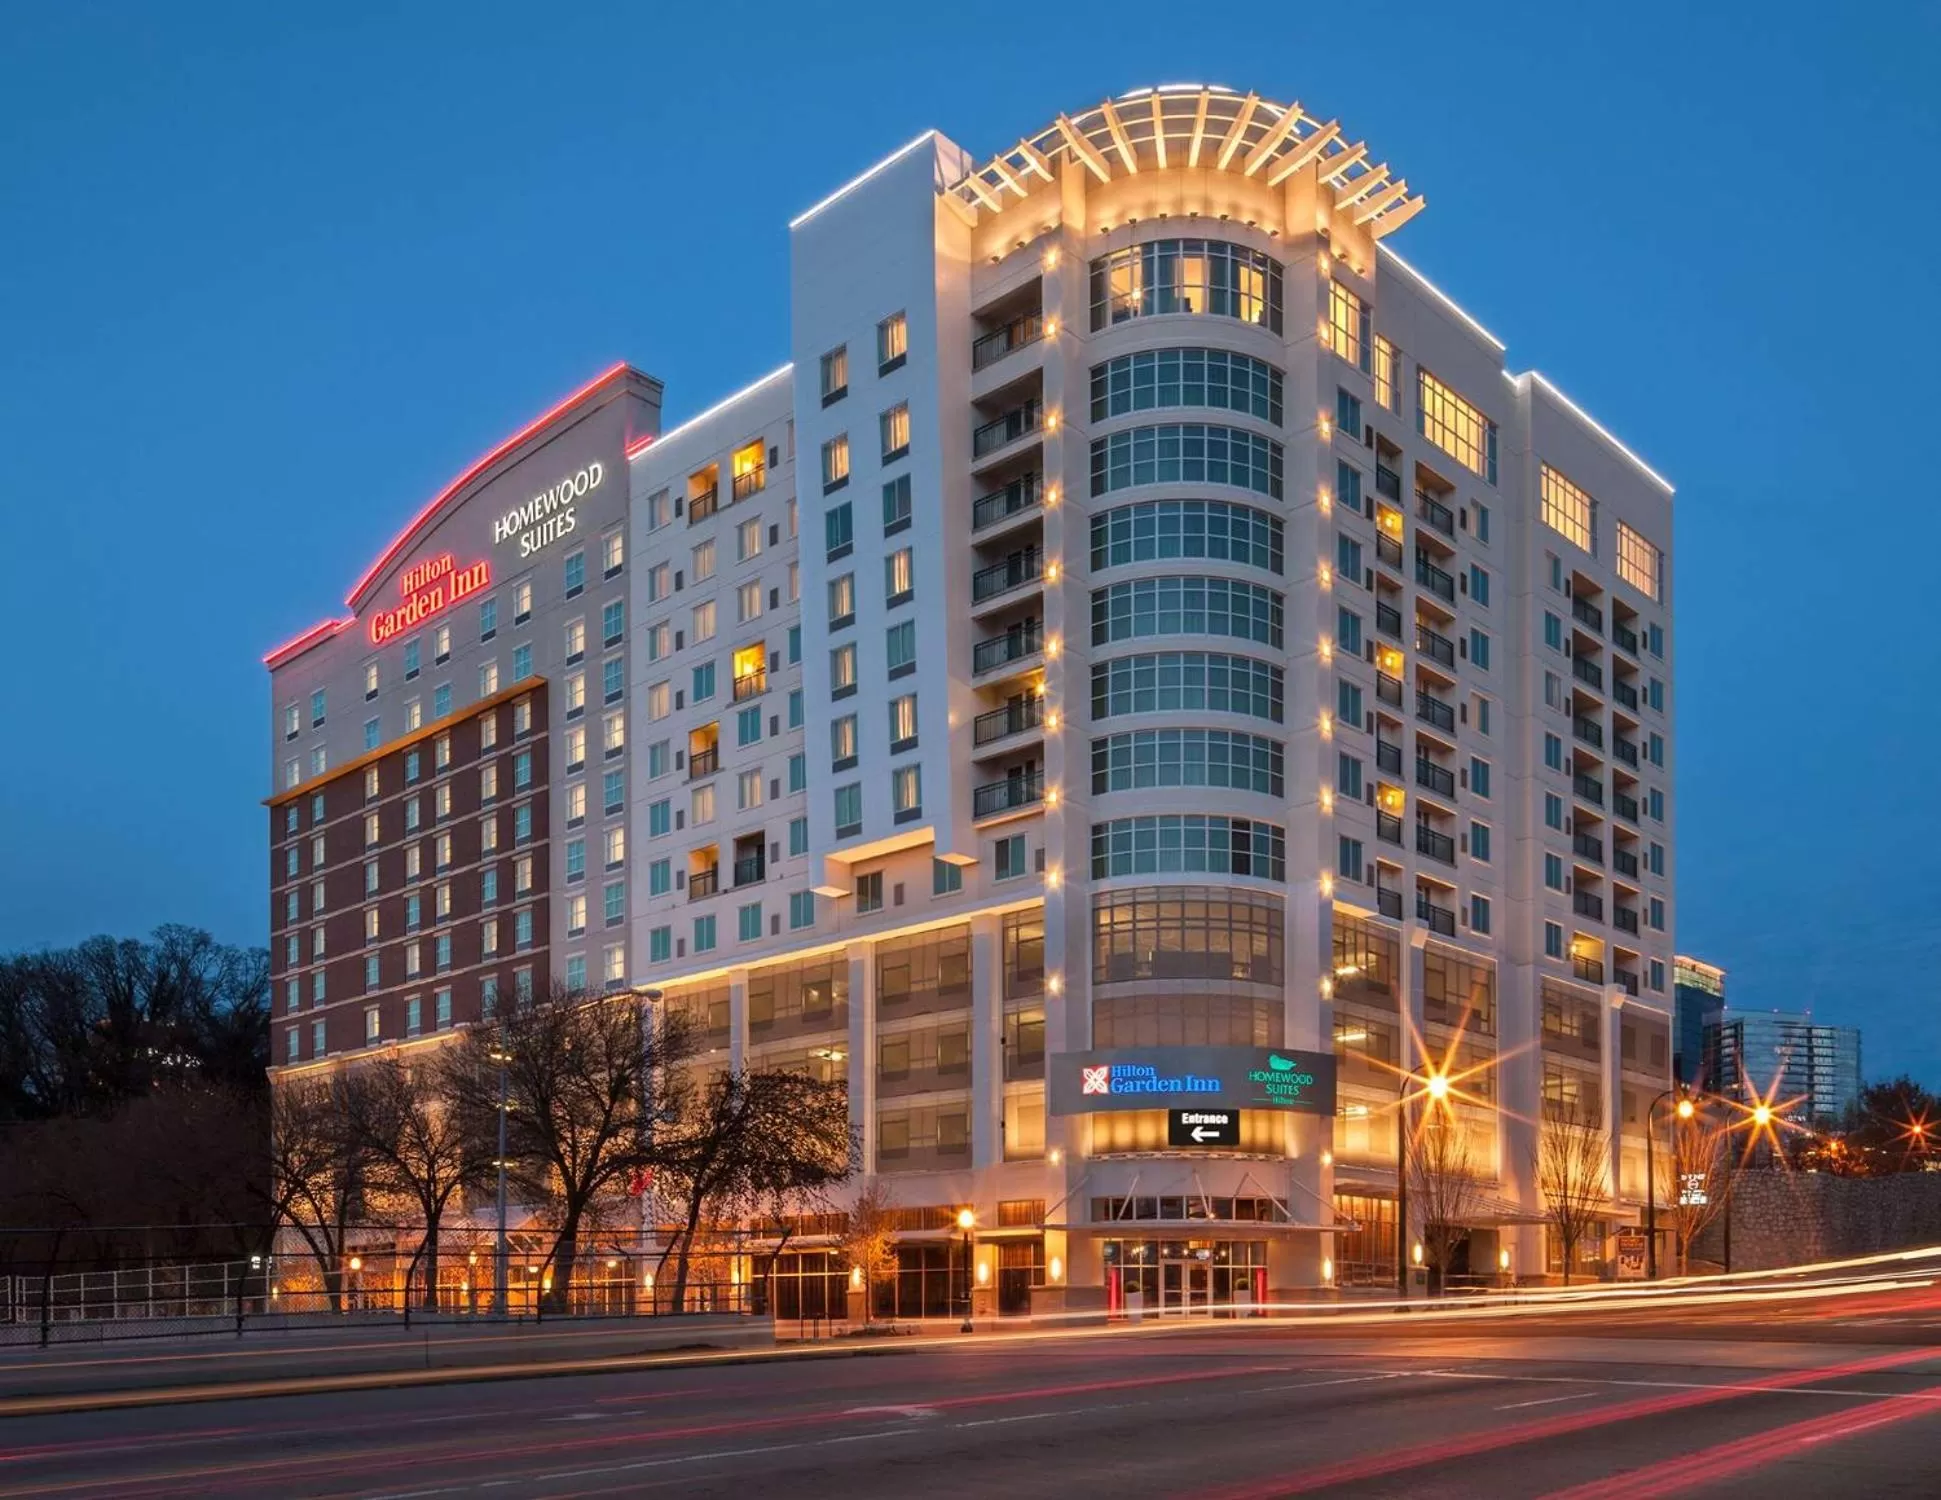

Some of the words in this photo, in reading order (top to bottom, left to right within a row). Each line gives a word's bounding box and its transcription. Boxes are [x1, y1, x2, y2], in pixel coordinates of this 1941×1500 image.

[494, 462, 603, 543] HOMEWOOD
[520, 507, 576, 558] SUITES
[402, 553, 453, 597] Hilton
[371, 585, 444, 645] Garden
[449, 560, 490, 602] Inn
[1111, 1065, 1155, 1078] Hilton
[1248, 1071, 1313, 1085] HOMEWOOD
[1110, 1076, 1182, 1094] Garden
[1185, 1075, 1221, 1093] Inn
[1265, 1083, 1300, 1096] SUITES
[1181, 1112, 1229, 1125] Entrance
